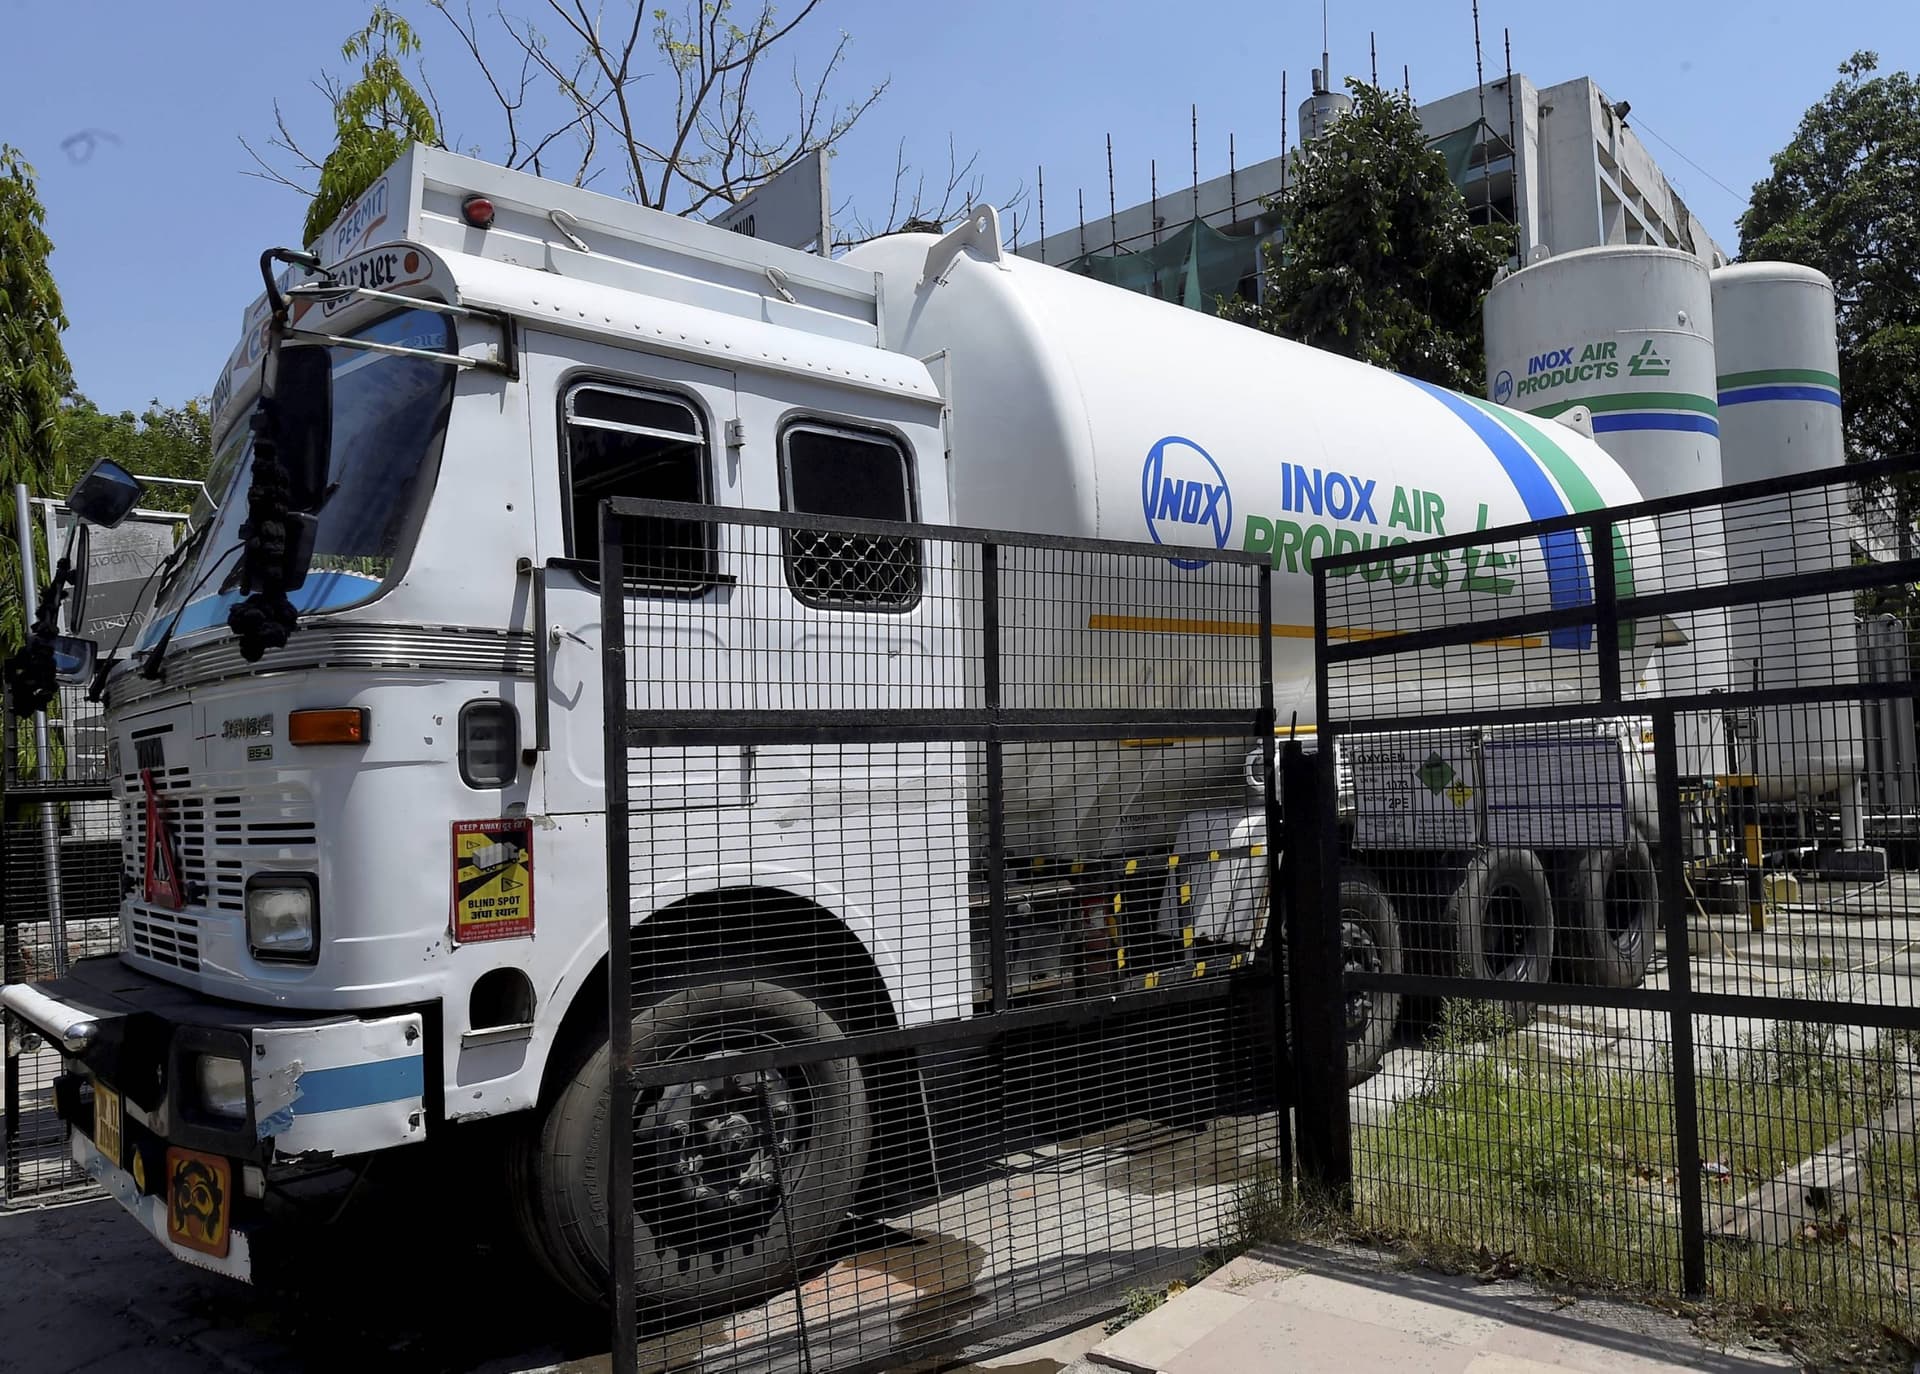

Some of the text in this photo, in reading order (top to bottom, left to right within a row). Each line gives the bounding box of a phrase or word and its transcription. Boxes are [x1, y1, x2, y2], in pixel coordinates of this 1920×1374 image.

[338, 185, 386, 254] PERMIT
[1528, 341, 1617, 375] INOX AIR
[1517, 361, 1619, 398] PRODUCTS
[1280, 461, 1446, 536] INOX AIR
[1358, 752, 1405, 763] OXYGEN
[1388, 797, 1409, 809] 2PE
[459, 823, 478, 832] KEEP
[468, 896, 521, 909] BLIND SPOT
